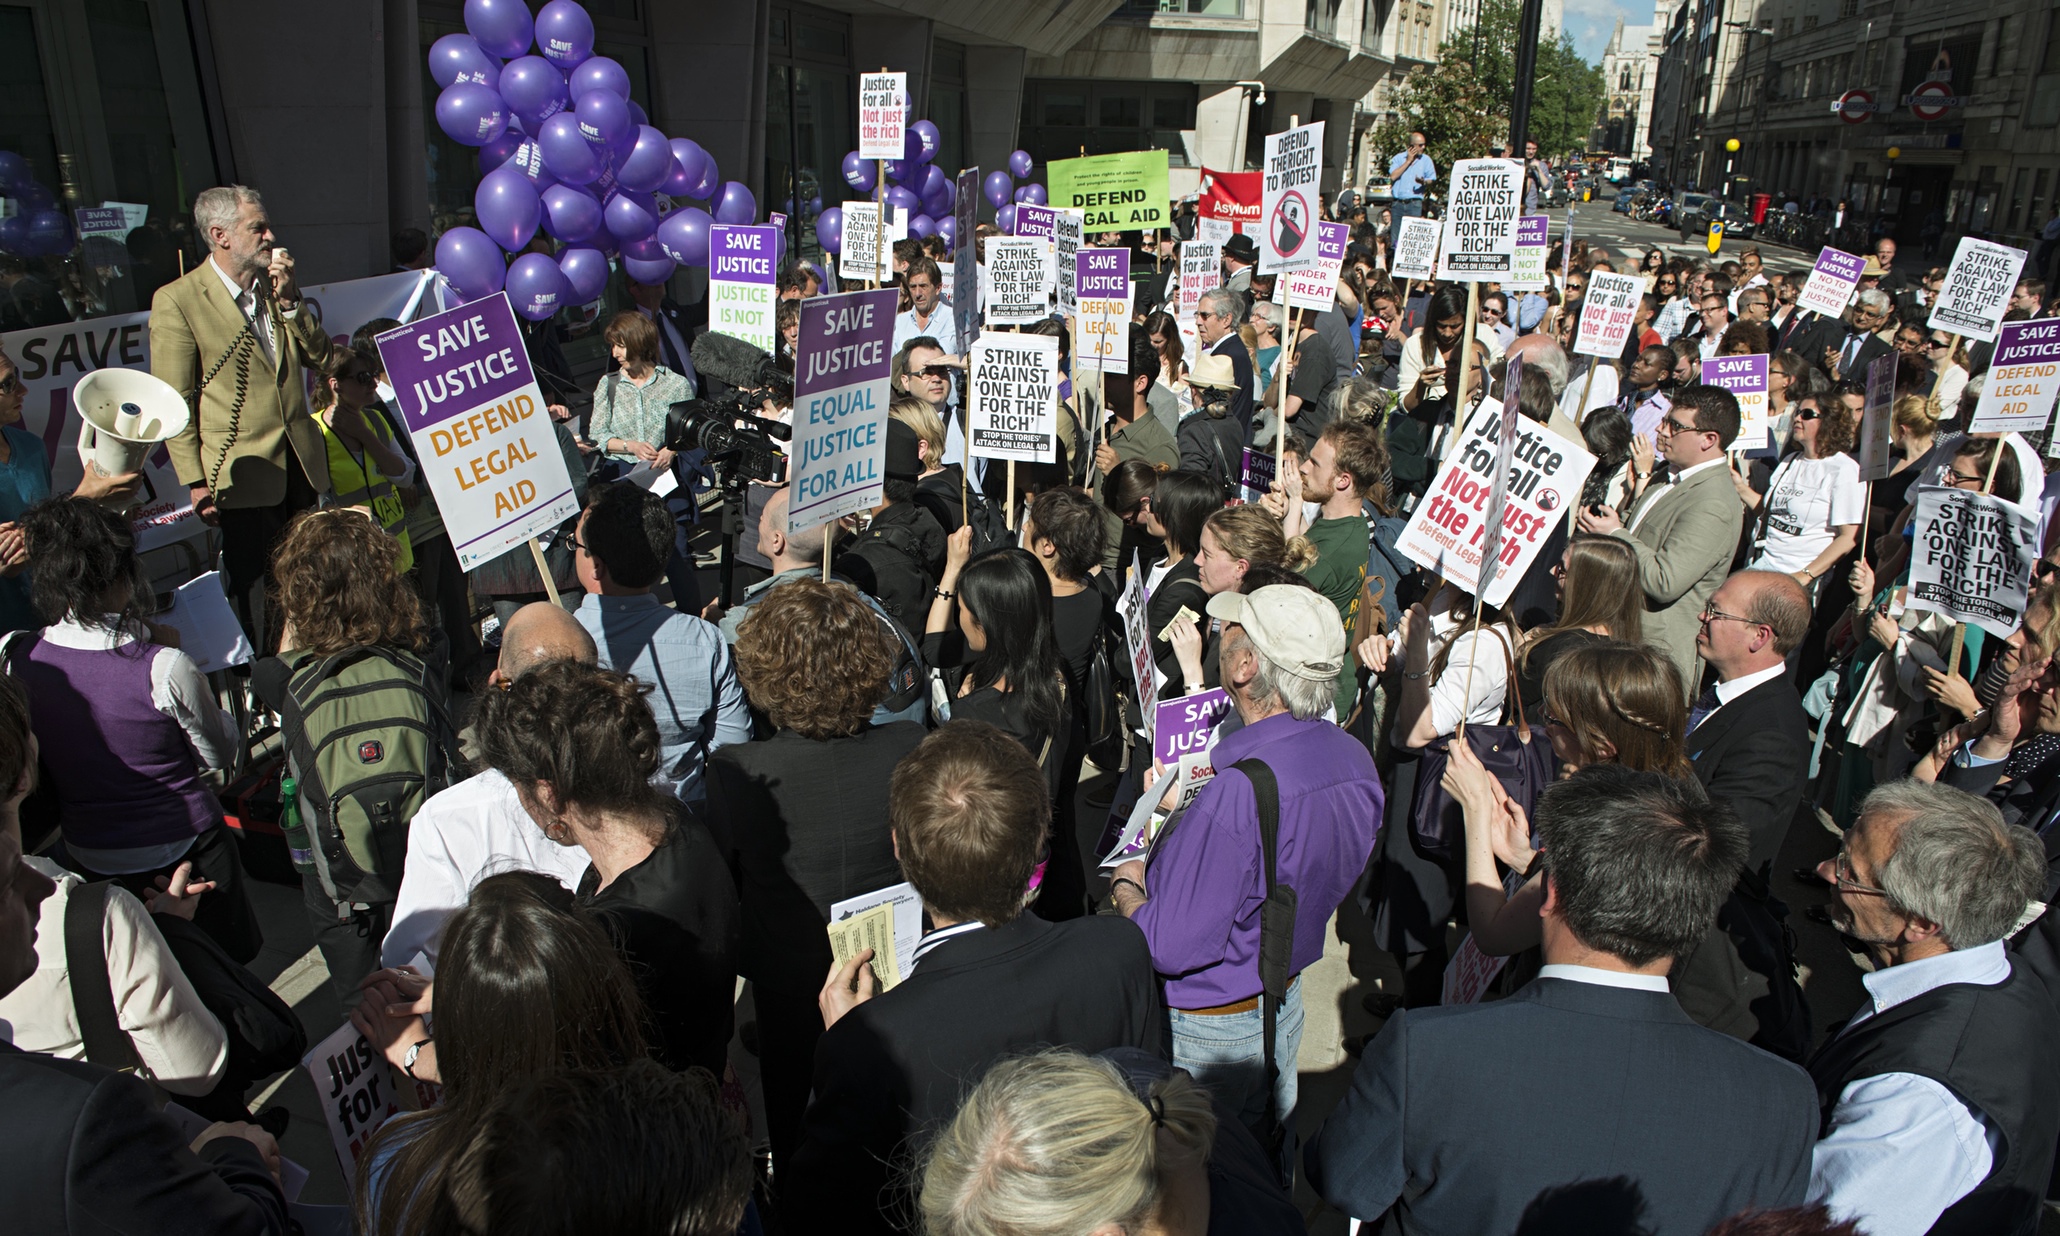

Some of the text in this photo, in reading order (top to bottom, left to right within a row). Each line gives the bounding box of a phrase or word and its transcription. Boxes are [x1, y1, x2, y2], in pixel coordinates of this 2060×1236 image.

[550, 38, 572, 51] SAVE
[862, 77, 896, 91] Justice
[862, 92, 892, 107] for all
[862, 109, 902, 125] Not just
[580, 121, 600, 137] SAVE
[862, 124, 900, 139] the rich
[1278, 130, 1309, 155] DEFEND
[515, 142, 531, 168] SAVE
[1271, 147, 1315, 173] THE RIGHT
[1266, 165, 1317, 192] TO PROTEST
[1461, 174, 1510, 189] STRIKE
[1072, 189, 1147, 207] DEFEND
[1454, 190, 1514, 206] AGAINST
[1028, 211, 1052, 223] SAVE
[1129, 208, 1161, 223] AID
[1213, 200, 1261, 217] Asylum
[1485, 206, 1515, 221] LAW
[846, 222, 888, 233] AGAINST
[1020, 223, 1055, 237] JUSTICE
[1057, 220, 1079, 238] Defend
[1407, 225, 1434, 235] STRIKE
[1455, 222, 1508, 237] FOR THE
[726, 233, 761, 250] SAVE
[847, 241, 865, 251] FOR
[1402, 232, 1435, 243] AGAINST
[1461, 238, 1498, 253] RICH'
[996, 248, 1038, 259] STRIKE
[1183, 243, 1214, 258] Justice
[1401, 247, 1430, 258] FOR THE
[716, 256, 769, 274] JUSTICE
[991, 259, 1043, 271] AGAINST
[1088, 255, 1117, 269] SAVE
[1183, 258, 1211, 273] for all
[1518, 260, 1537, 269] NOT
[1831, 253, 1856, 267] SAVE
[1965, 251, 2011, 271] STRIKE
[1021, 270, 1045, 281] LAW
[1521, 272, 1544, 281] SALE
[1819, 261, 1857, 279] JUSTICE
[1955, 262, 2012, 283] AGAINST
[994, 282, 1042, 293] FOR THE
[1082, 276, 1124, 292] JUSTICE
[1183, 274, 1218, 290] Not just
[1278, 279, 1334, 298] THREAT
[1592, 275, 1634, 294] Justice
[1818, 274, 1847, 289] NO TO
[1981, 279, 2010, 296] LAW
[535, 292, 558, 304] SAVE
[716, 285, 768, 303] JUSTICE
[1182, 289, 1198, 303] the
[1588, 290, 1626, 308] for all
[1808, 281, 1848, 300] CUT-PRICE
[1948, 284, 2002, 307] FOR THE
[1082, 301, 1125, 315] DEFEND
[1805, 291, 1842, 309] JUSTICE
[720, 308, 764, 326] IS NOT
[823, 304, 875, 336] SAVE
[1583, 305, 1633, 325] Not just
[417, 314, 490, 362] SAVE
[1582, 320, 1625, 339] the rich
[2018, 325, 2059, 341] SAVE
[21, 323, 145, 381] SAVE
[984, 348, 1043, 368] STRIKE
[2000, 343, 2060, 362] JUSTICE
[805, 340, 884, 385] JUSTICE
[1718, 360, 1753, 373] SAVE
[976, 364, 1050, 384] AGAINST
[1995, 365, 2056, 380] DEFEND
[413, 347, 519, 417] JUSTICE
[1017, 384, 1052, 401] LAW
[1995, 384, 2041, 398] LEGAL
[809, 388, 876, 425] EQUAL
[979, 397, 1046, 417] FOR THE
[1999, 401, 2028, 415] AID
[429, 394, 536, 458] DEFEND
[989, 414, 1035, 432] RICH'
[982, 430, 1014, 440] STOP THE
[801, 422, 877, 471] JUSTICE
[975, 439, 1048, 451] ATTACK ON LEGAL AID
[453, 437, 538, 492] LEGAL
[1250, 456, 1276, 474] SAVE
[798, 458, 878, 503] FOR ALL
[1440, 465, 1493, 512] Not
[1505, 466, 1541, 501] all
[494, 479, 537, 519] AID
[1776, 486, 1804, 498] Save
[1774, 495, 1792, 508] UK
[1426, 494, 1469, 536] the
[1938, 504, 2015, 541] STRIKE
[1417, 519, 1457, 551] Defend
[1784, 524, 1798, 535] All
[1926, 519, 2021, 559] AGAINST
[1927, 550, 2015, 590] FOR THE
[1977, 549, 2023, 575] LAW
[1928, 584, 1968, 604] STOP THE
[1917, 592, 1951, 606] ATTACK
[1952, 602, 1965, 612] ON
[1966, 605, 1996, 619] LEGAL
[1996, 614, 2013, 625] AID
[337, 1073, 382, 1138] for
